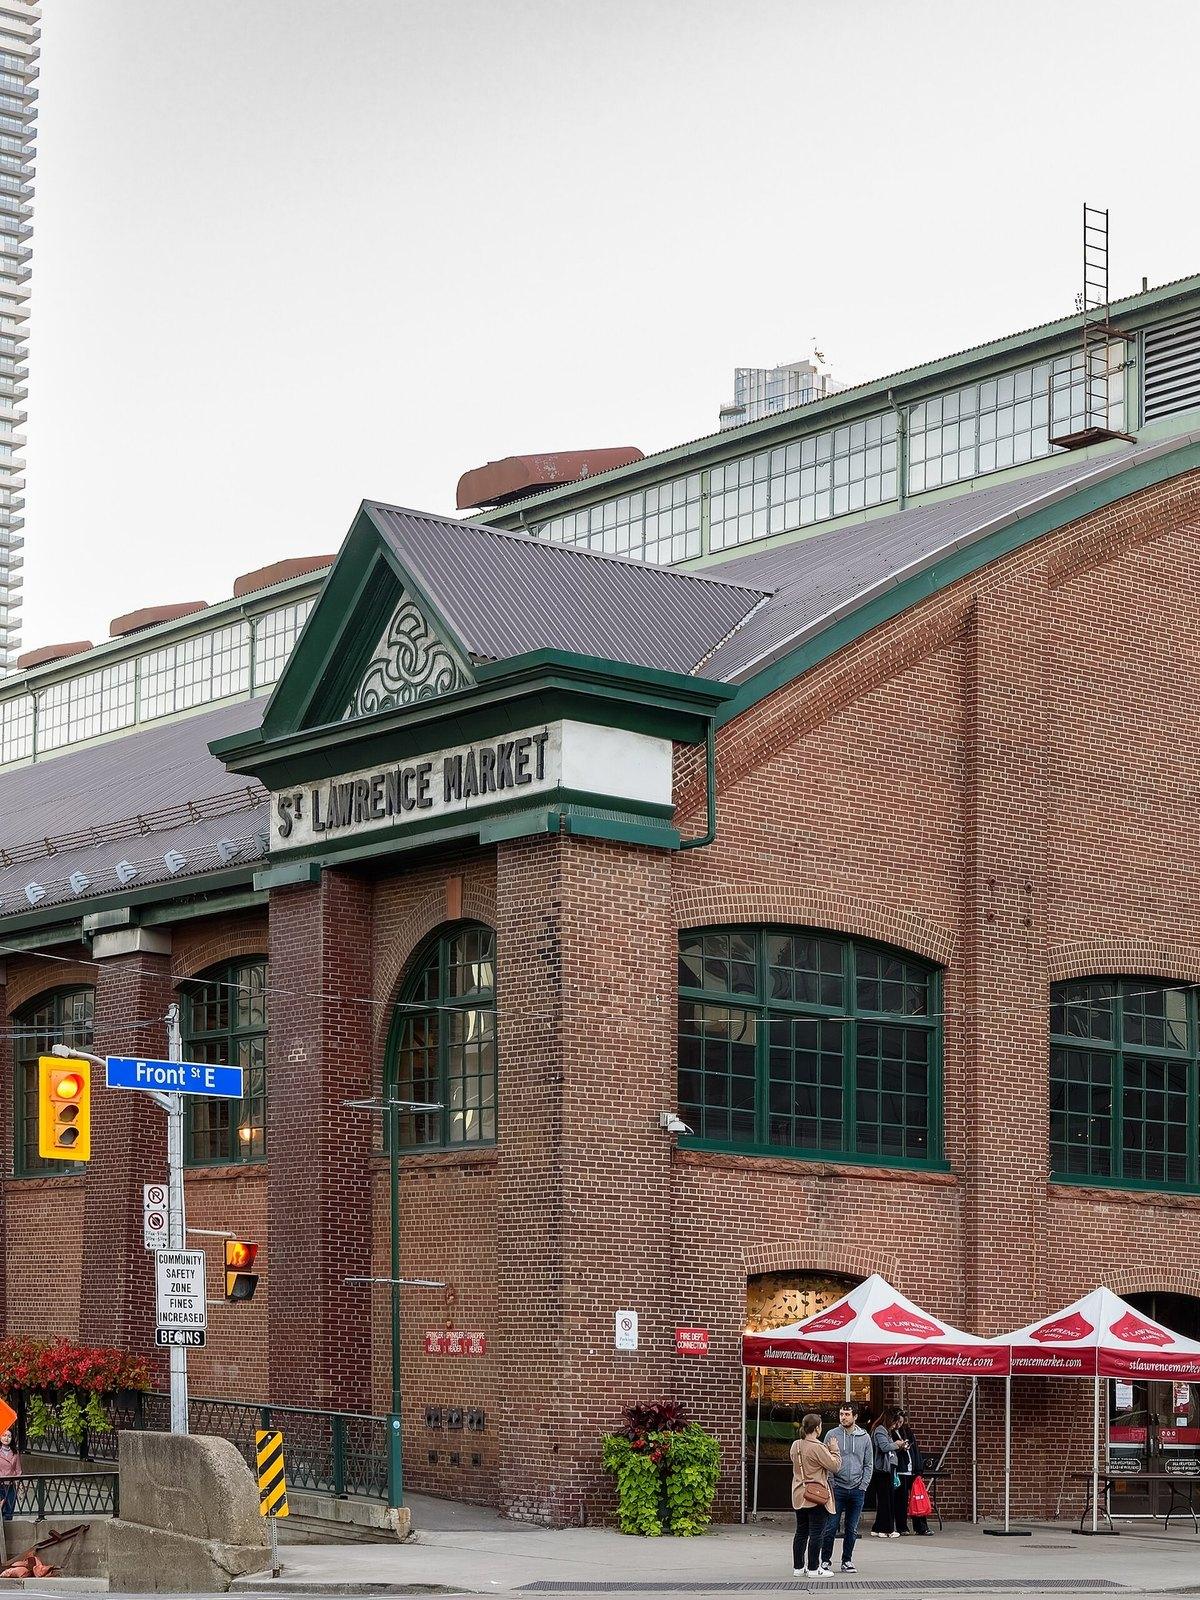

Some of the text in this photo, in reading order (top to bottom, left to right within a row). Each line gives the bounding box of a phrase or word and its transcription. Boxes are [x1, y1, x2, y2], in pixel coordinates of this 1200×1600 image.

[312, 762, 432, 832] LAWRENCE
[443, 732, 549, 802] MARKET
[136, 1062, 216, 1088] Front St E
[158, 1253, 202, 1265] COMMUNITY
[166, 1269, 195, 1279] SAFETY
[171, 1283, 192, 1293] ZONE
[170, 1299, 193, 1309] FINES
[159, 1312, 204, 1323] INCREASED
[680, 1332, 691, 1341] FIRE
[677, 1340, 707, 1350] CONNECTION
[764, 1346, 835, 1364] stlawrencemarket.com
[884, 1351, 994, 1367] stlawrencemarket.com
[1010, 1354, 1082, 1368] wrencemarket.com
